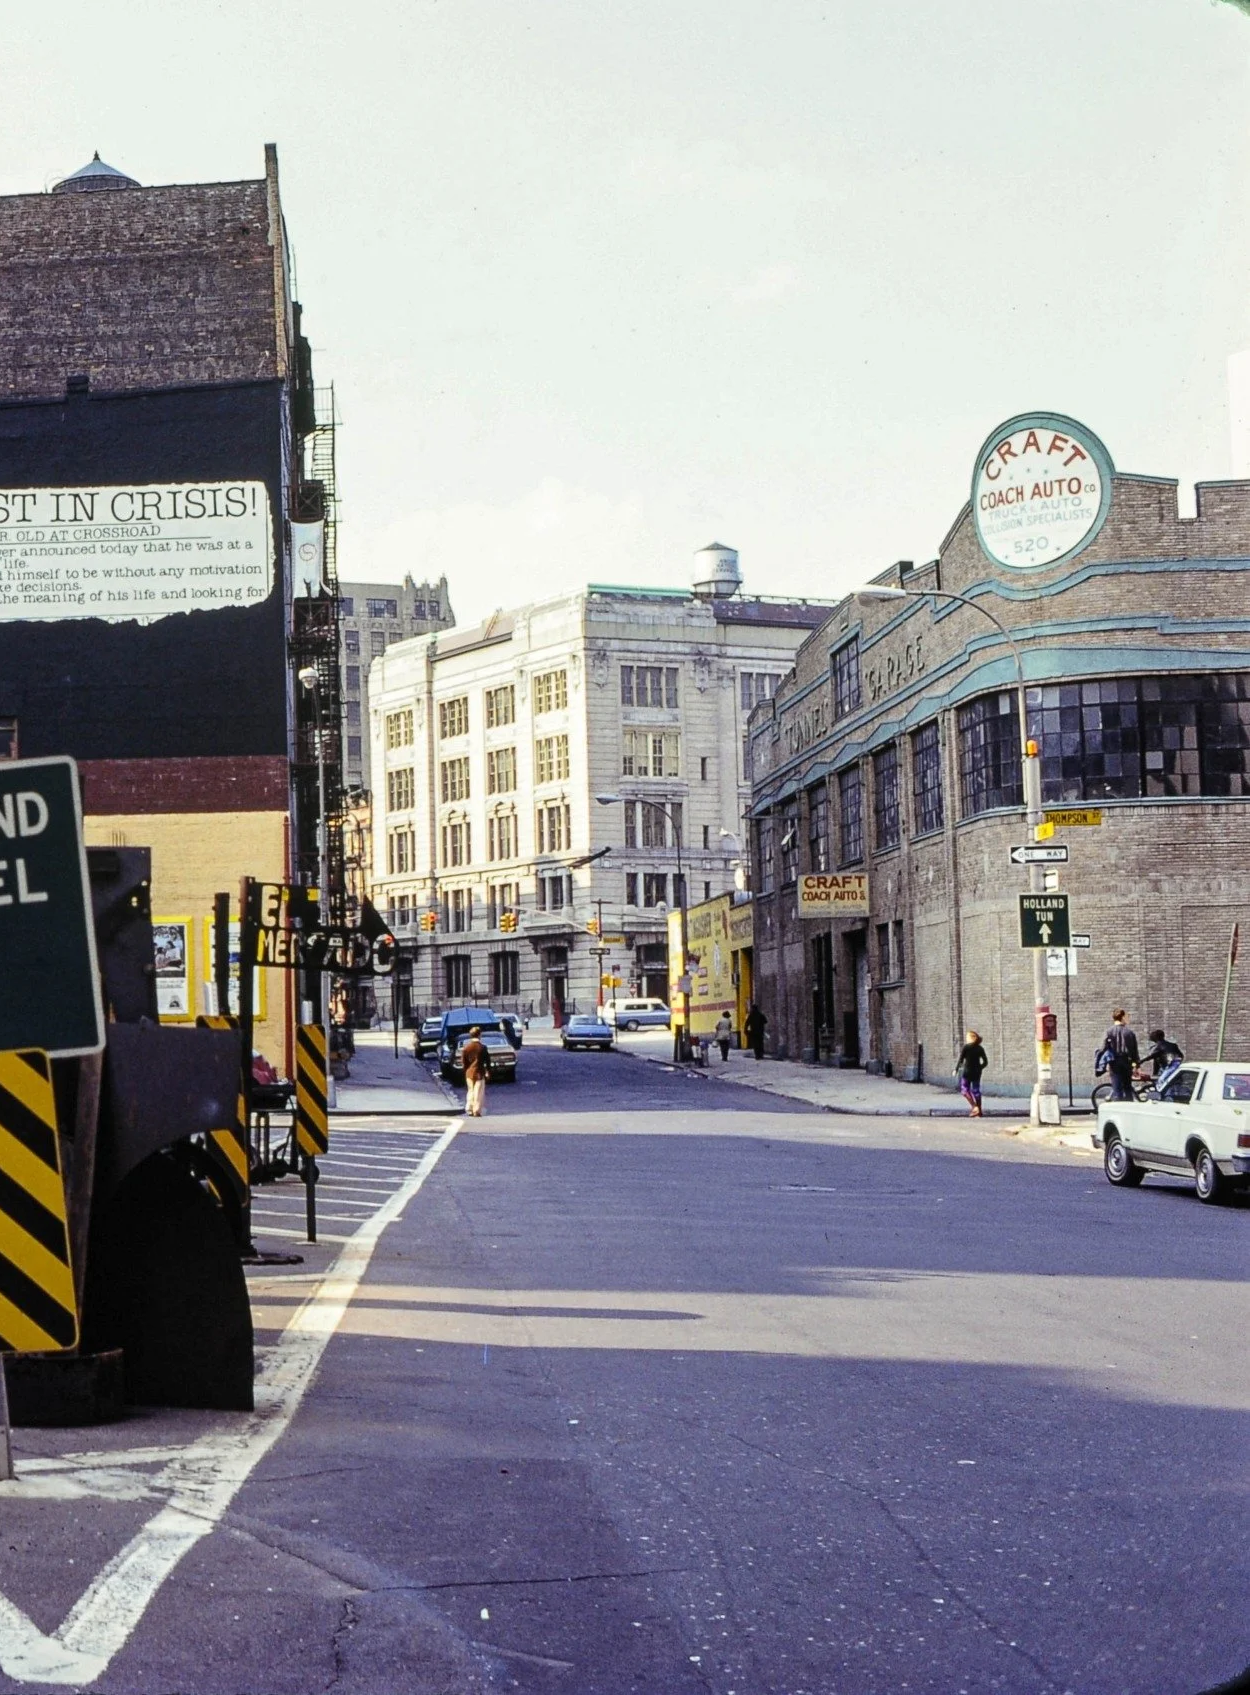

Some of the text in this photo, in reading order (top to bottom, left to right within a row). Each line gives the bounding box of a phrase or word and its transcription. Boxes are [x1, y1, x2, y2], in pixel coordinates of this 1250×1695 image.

[985, 431, 1087, 481] CRAFT
[980, 477, 1096, 511] COACH AUTO CO
[50, 492, 100, 523] IN
[110, 486, 257, 522] CRISIS!
[988, 503, 1029, 522] TRUCK
[1040, 496, 1082, 511] AUTO
[1026, 507, 1094, 527] SPECIALISTS
[16, 530, 45, 541] OLD
[49, 529, 69, 542] AT
[73, 525, 161, 541] CROSSROAD
[20, 543, 97, 557] announced
[101, 542, 138, 556] today
[143, 541, 171, 553] that
[176, 541, 192, 552] he
[196, 541, 223, 551] was
[227, 540, 241, 550] at
[245, 541, 253, 550] a
[1013, 536, 1050, 554] 520
[3, 558, 30, 569] life.
[7, 568, 61, 581] himself
[66, 570, 79, 580] to
[82, 568, 98, 579] be
[102, 566, 157, 579] without
[159, 567, 185, 580] any
[189, 564, 263, 576] motivation
[16, 580, 83, 594] decisions.
[23, 590, 86, 605] meaning
[89, 590, 106, 602] of
[107, 589, 129, 601] his
[133, 588, 157, 601] life
[161, 587, 187, 600] and
[191, 586, 243, 601] looking
[247, 585, 266, 598] for
[1045, 812, 1088, 824] THOMPSON
[804, 875, 865, 889] CRAFT
[802, 891, 831, 902] COACH
[834, 890, 858, 901] AUTO
[1023, 898, 1065, 909] HOLLAND
[1035, 911, 1054, 922] TUN
